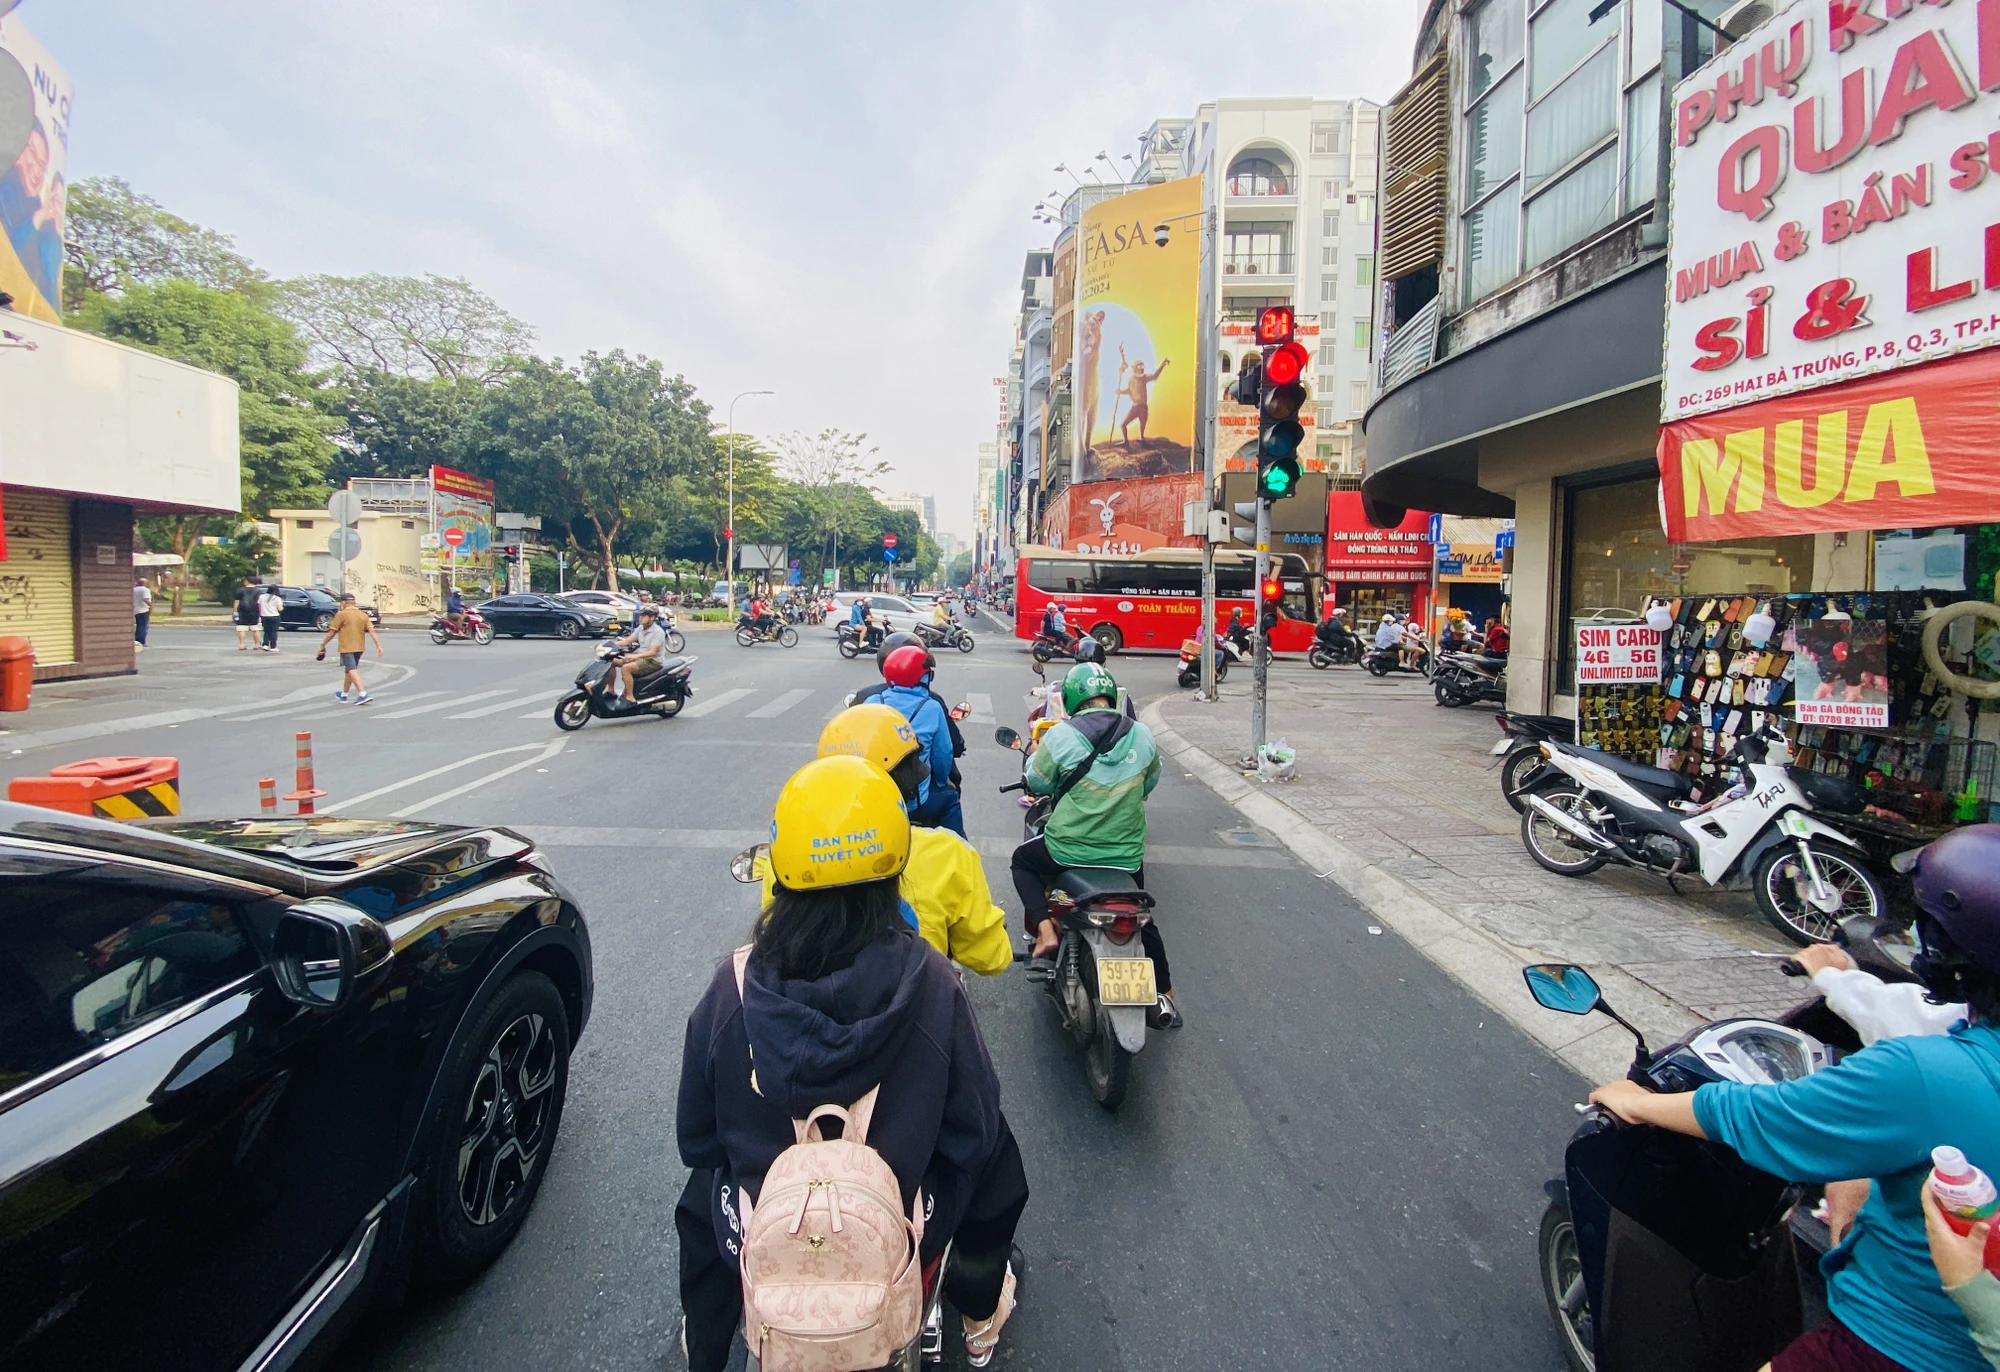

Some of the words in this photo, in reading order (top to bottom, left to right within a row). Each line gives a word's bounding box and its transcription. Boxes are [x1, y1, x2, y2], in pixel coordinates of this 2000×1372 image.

[1678, 19, 1812, 147] PHỤ
[1676, 240, 1764, 302] MUA
[1774, 221, 1809, 261] &
[1822, 170, 1933, 244] BÁN
[1263, 312, 1289, 338] 21
[1690, 285, 1773, 372] SỈ
[1793, 277, 1873, 341] &
[1704, 384, 1731, 403] 269
[1734, 376, 1763, 395] HAI
[1766, 365, 1788, 386] BÀ
[1792, 350, 1860, 380] TRƯNG,
[1864, 341, 1902, 362] P.8,
[1906, 328, 1949, 351] Q.3,
[1681, 396, 1936, 518] MUA
[1138, 603, 1162, 613] TOÀN
[1579, 629, 1611, 648] SIM
[1616, 628, 1661, 647] CARD
[1584, 650, 1609, 664] 4G
[1630, 649, 1656, 663] 5G
[1086, 676, 1114, 687] Grab
[1580, 666, 1633, 680] UNLIMITED
[1636, 666, 1658, 679] DATA
[1860, 717, 1882, 726] 1111
[1752, 781, 1786, 808] TAFU
[810, 847, 854, 864] TUYỆT
